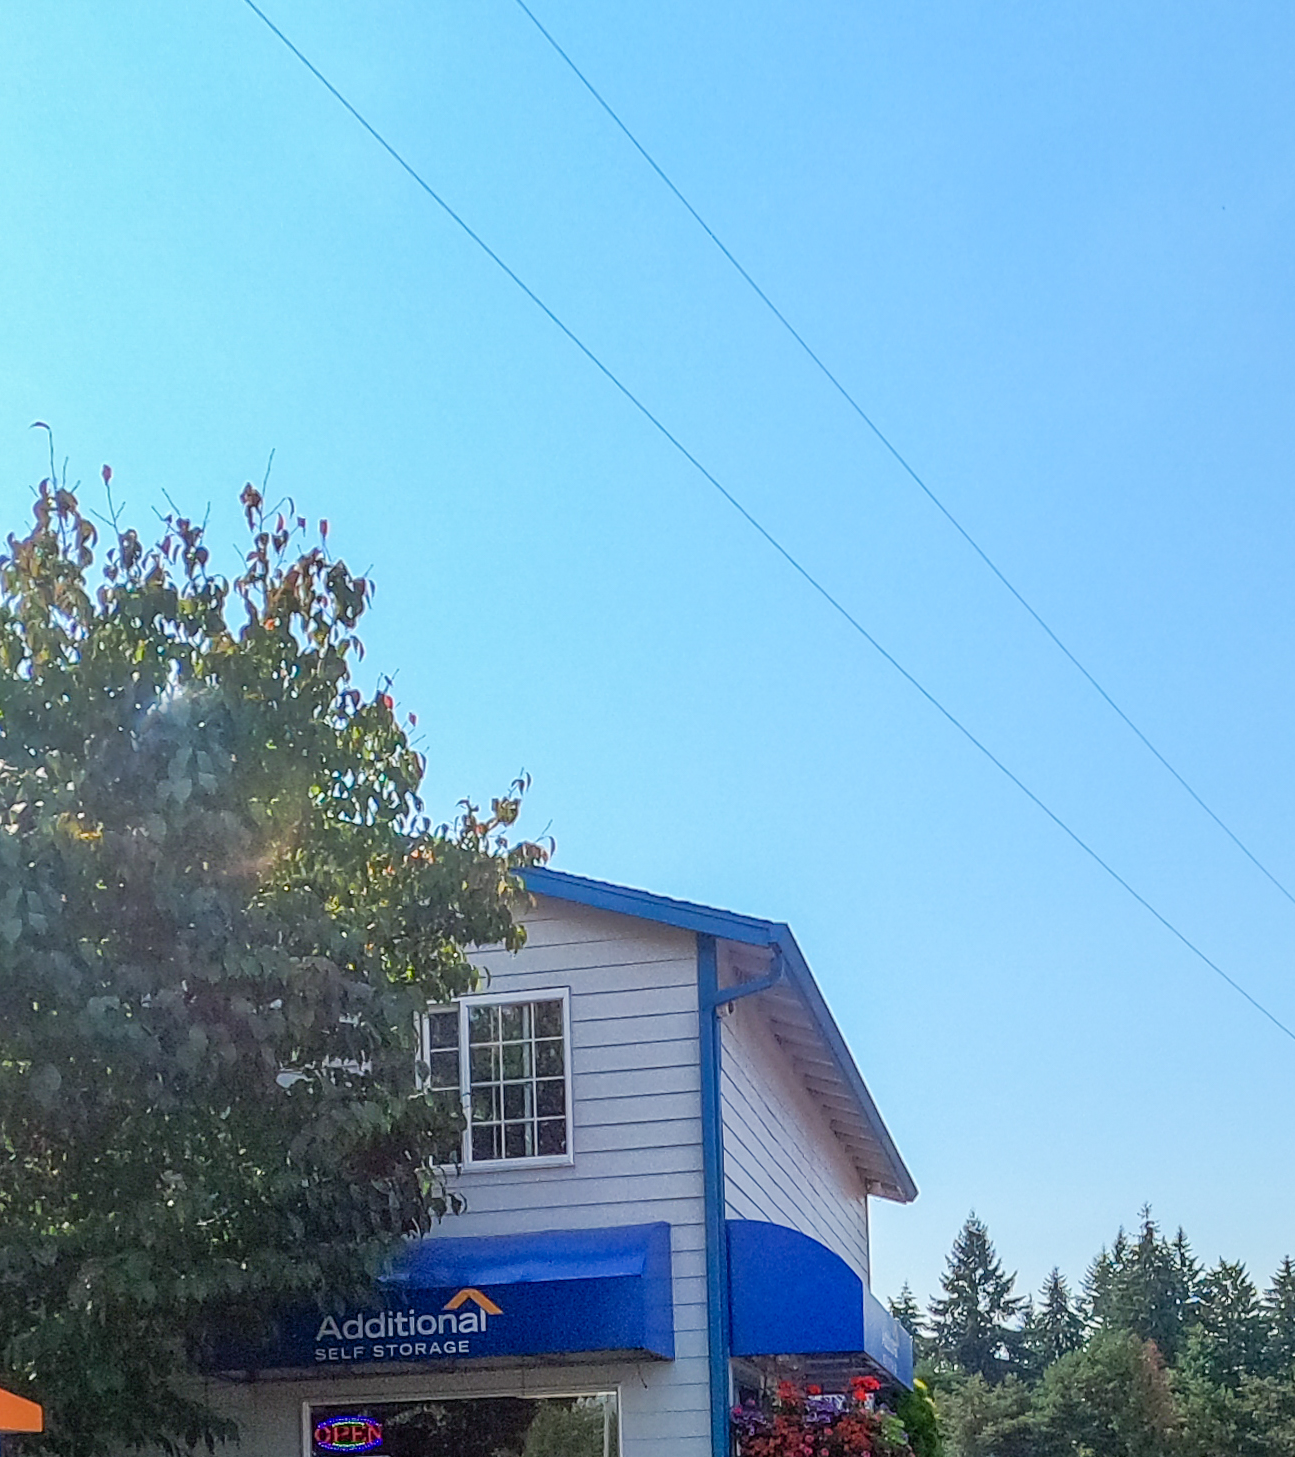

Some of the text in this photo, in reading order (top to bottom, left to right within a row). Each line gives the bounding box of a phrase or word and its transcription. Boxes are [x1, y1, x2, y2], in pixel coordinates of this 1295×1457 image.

[316, 1309, 487, 1341] Additional
[314, 1340, 470, 1362] SELF STORAGE
[314, 1422, 383, 1443] OPEN
